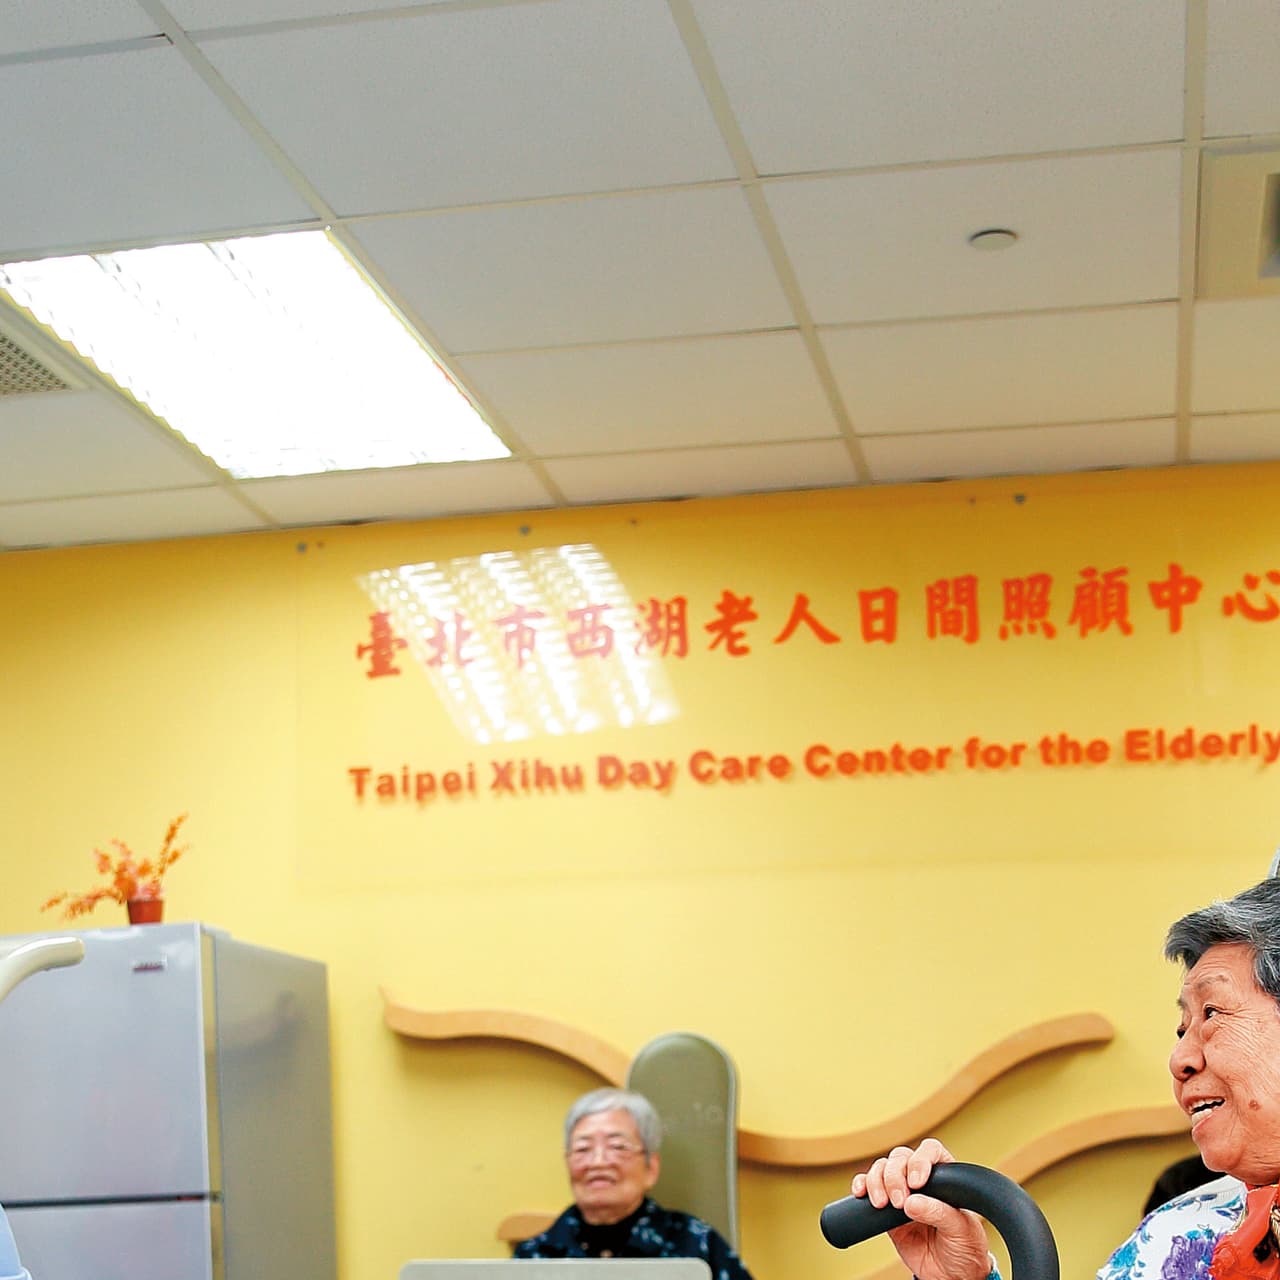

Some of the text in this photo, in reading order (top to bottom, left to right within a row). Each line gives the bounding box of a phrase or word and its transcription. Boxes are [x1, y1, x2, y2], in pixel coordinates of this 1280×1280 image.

[349, 763, 477, 801] Taipei
[491, 758, 584, 794] Xihu
[596, 755, 676, 792] Day
[688, 749, 793, 784] Care
[802, 742, 954, 779] Center
[962, 735, 1029, 771] for
[1036, 731, 1113, 768] the
